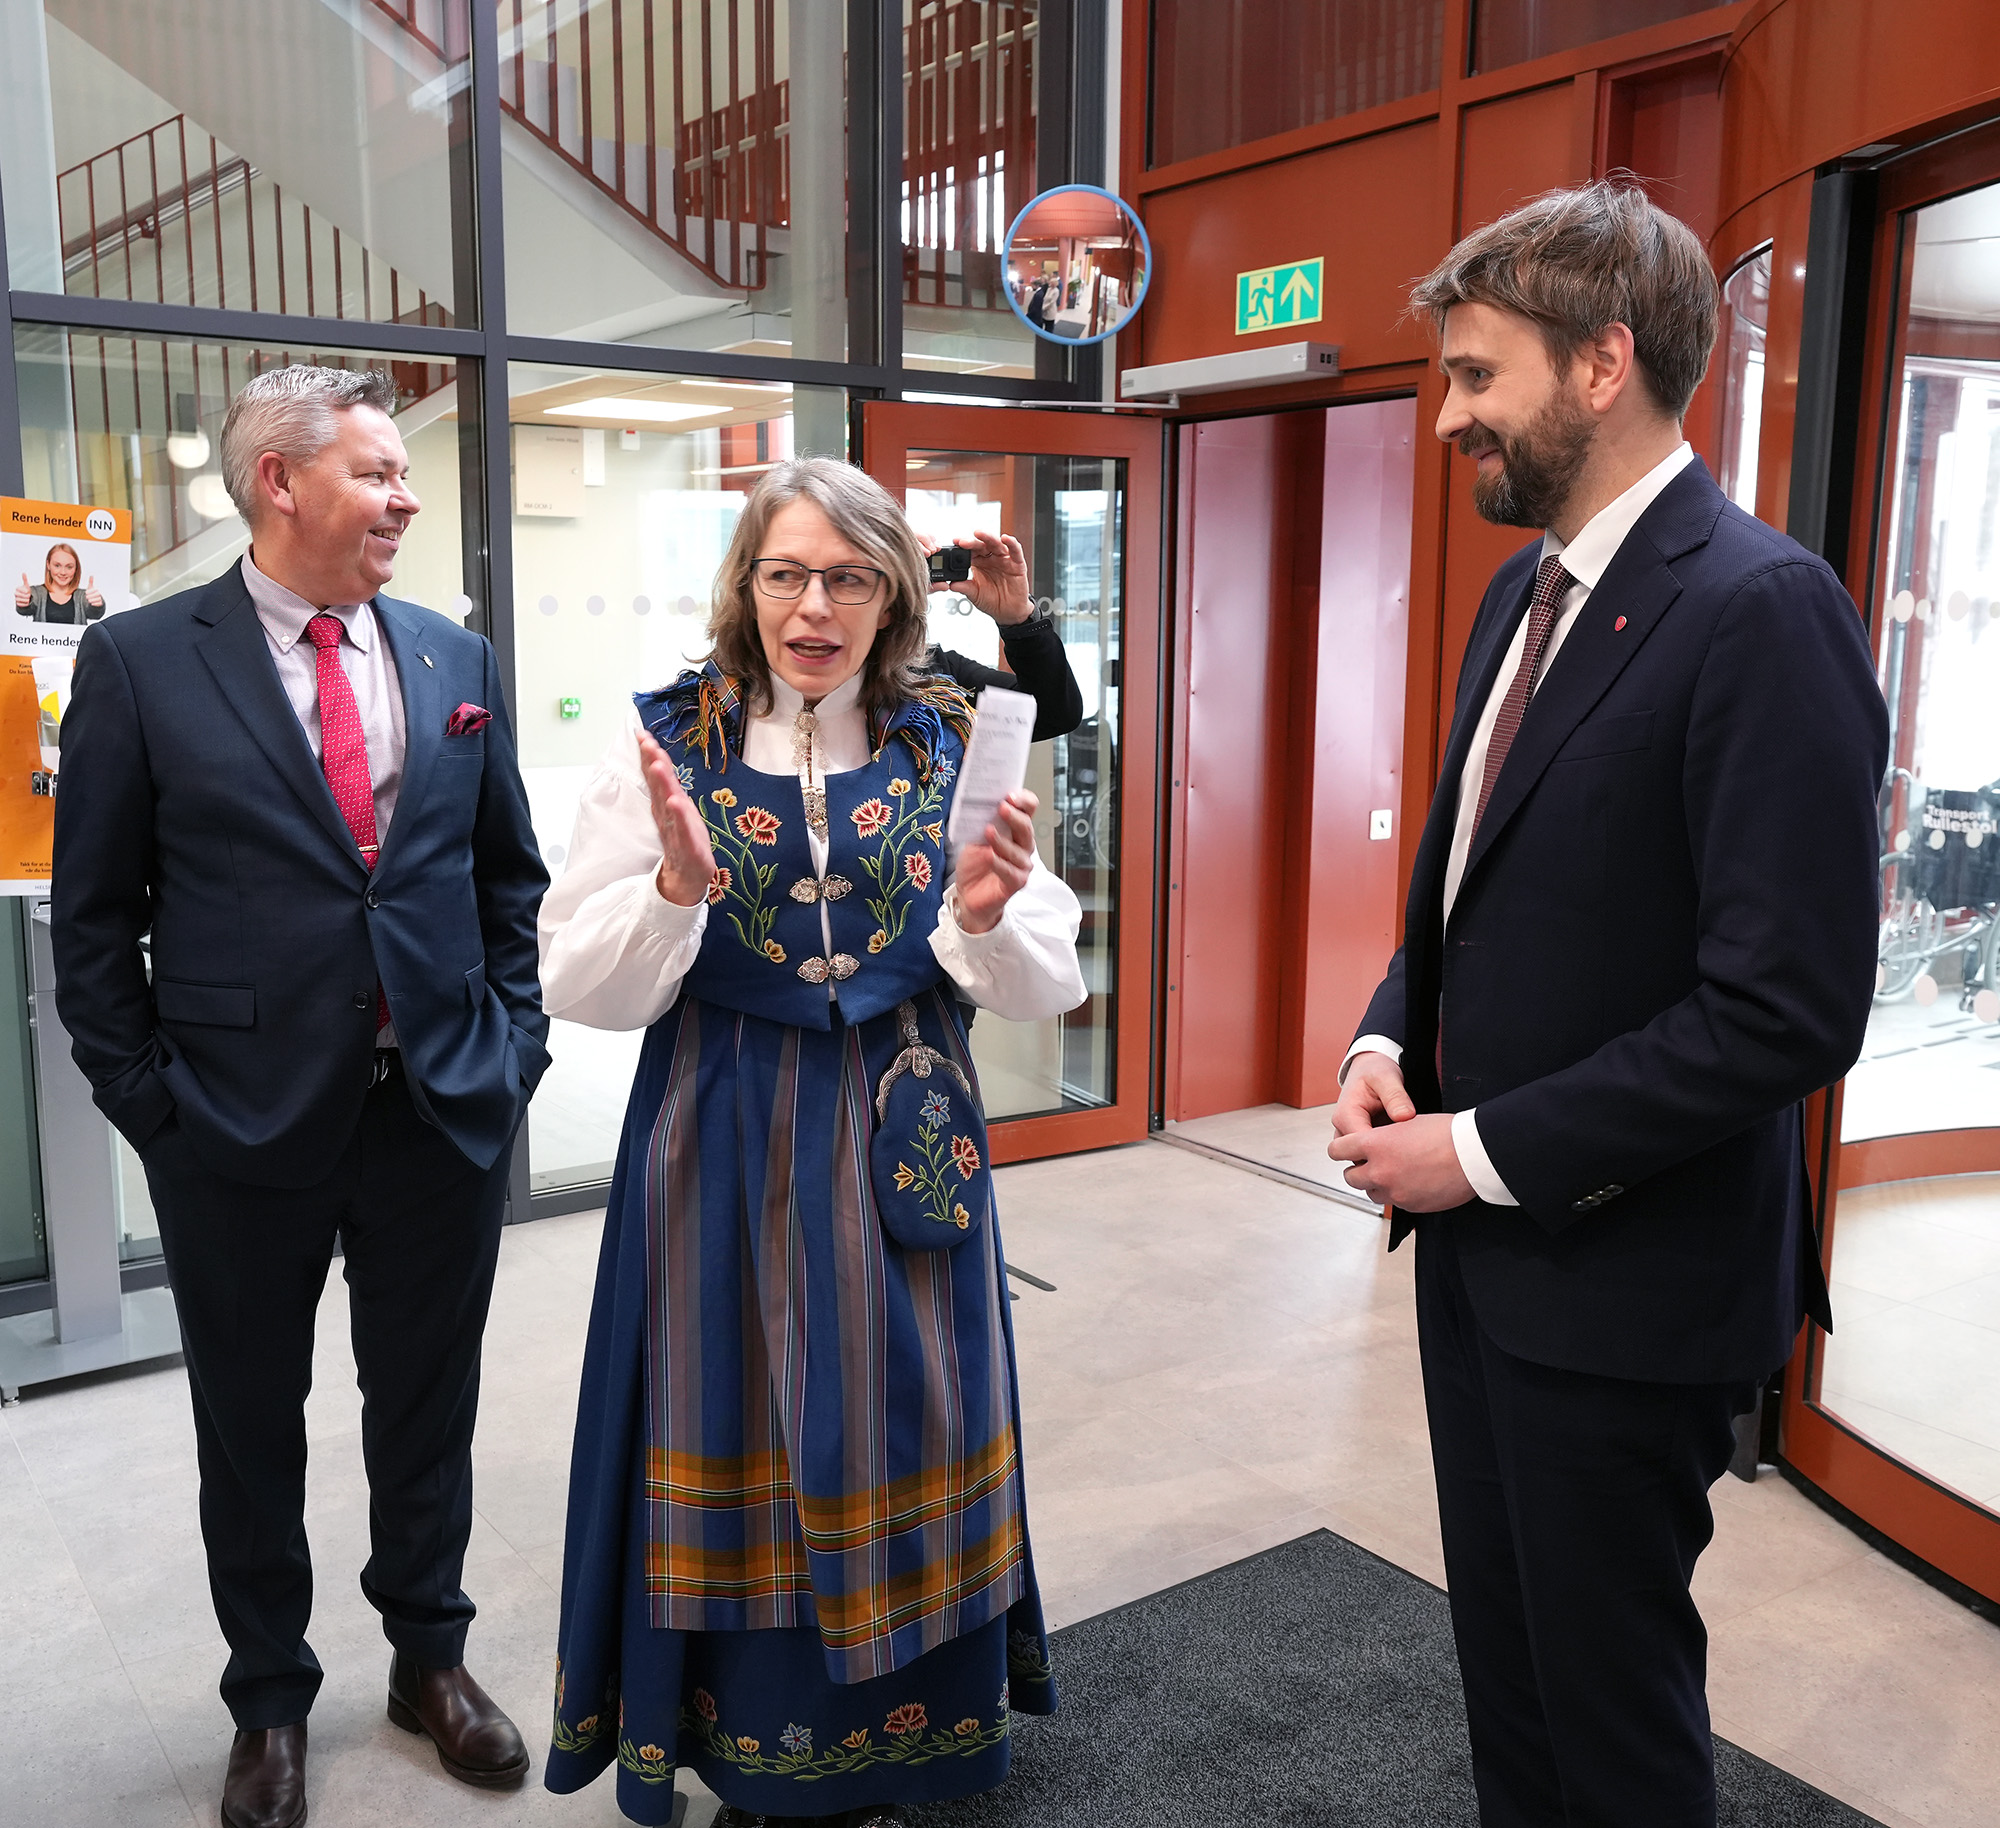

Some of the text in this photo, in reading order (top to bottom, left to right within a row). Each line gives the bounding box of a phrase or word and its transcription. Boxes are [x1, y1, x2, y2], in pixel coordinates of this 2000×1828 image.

[12, 511, 113, 531] Rene hender INN
[9, 633, 80, 647] Rene hender
[1926, 804, 1989, 821] Transport
[1922, 813, 1998, 834] Rullestol
